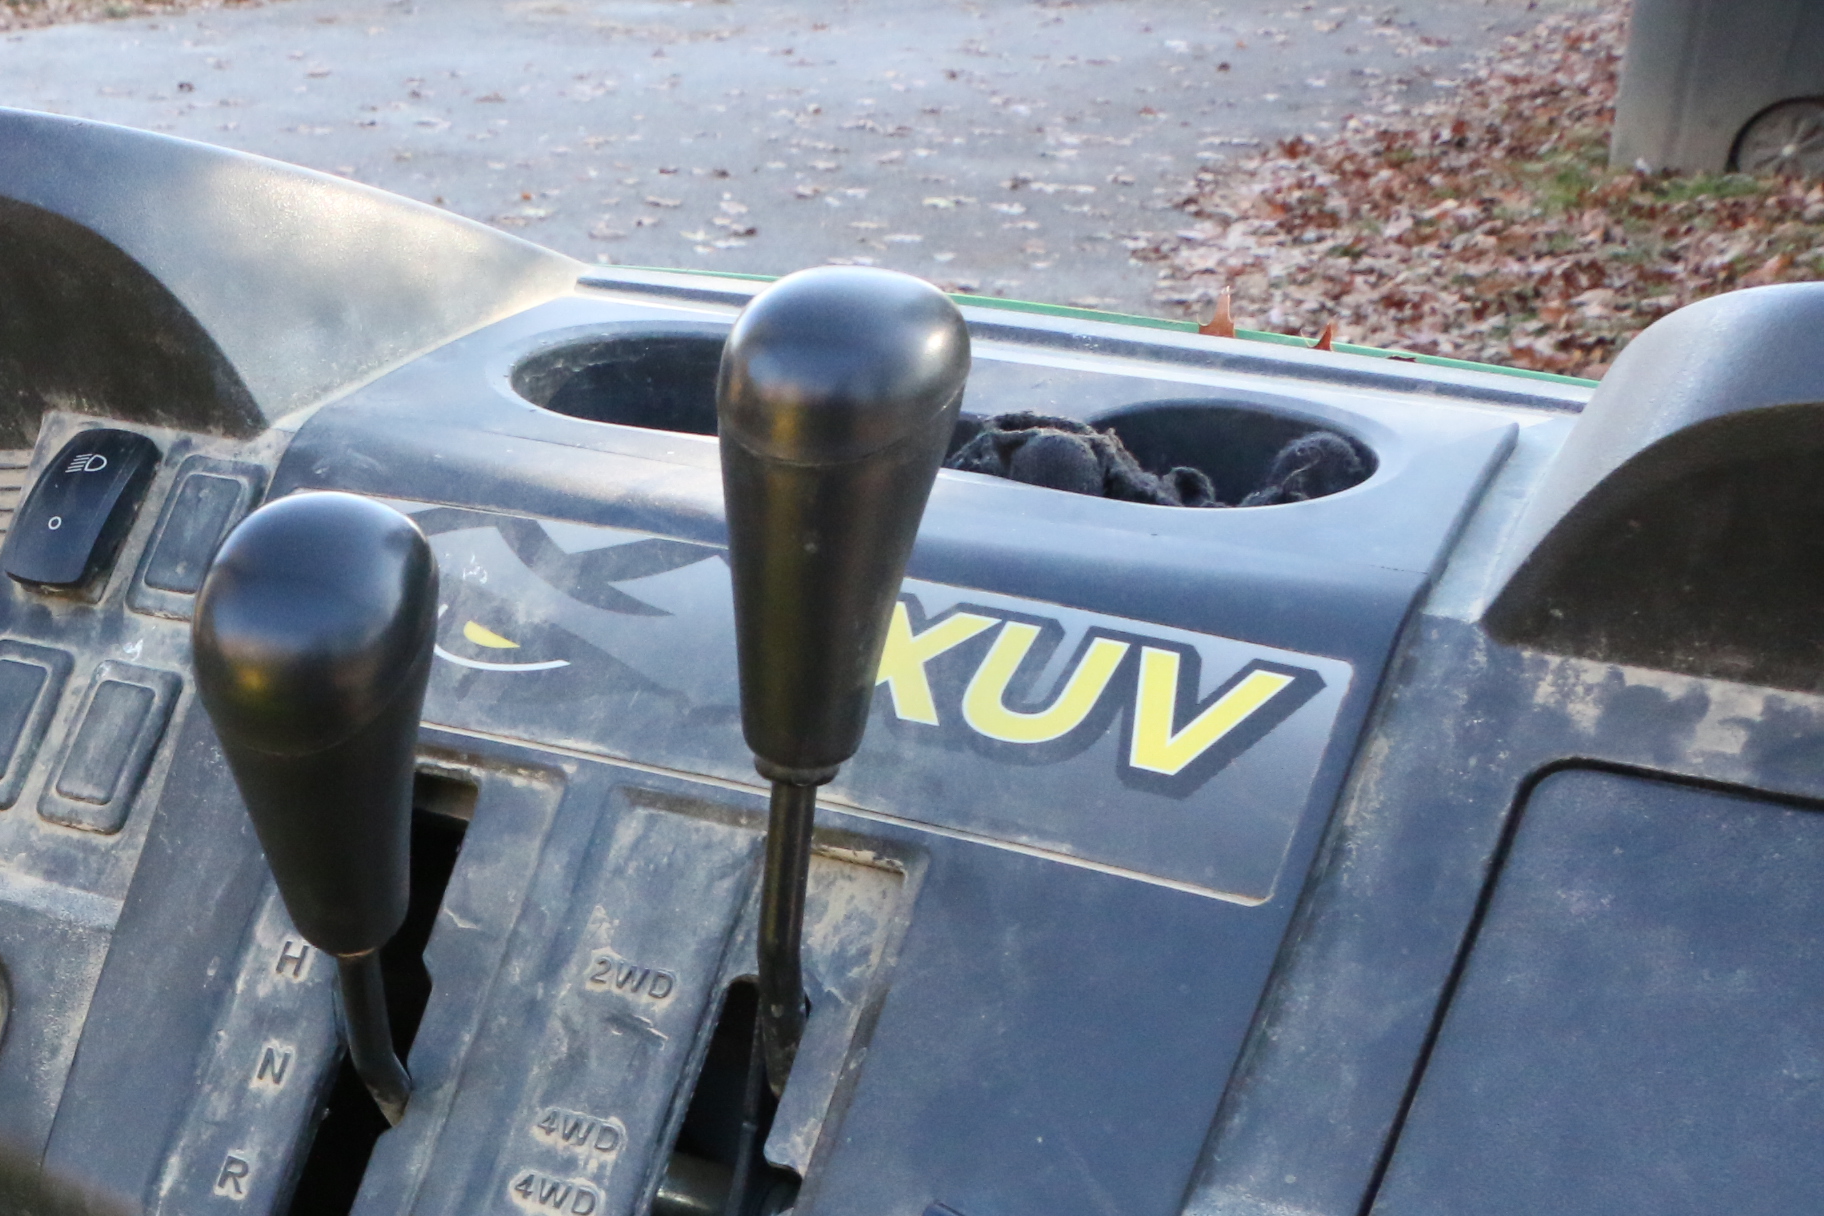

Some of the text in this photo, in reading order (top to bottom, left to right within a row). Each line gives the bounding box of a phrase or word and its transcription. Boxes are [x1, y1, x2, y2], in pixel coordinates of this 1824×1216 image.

[873, 602, 1295, 777] XUV
[276, 940, 309, 978] H
[589, 955, 674, 1000] 2WD
[257, 1046, 291, 1086] N
[536, 1109, 619, 1155] 4WD
[217, 1155, 249, 1196] R
